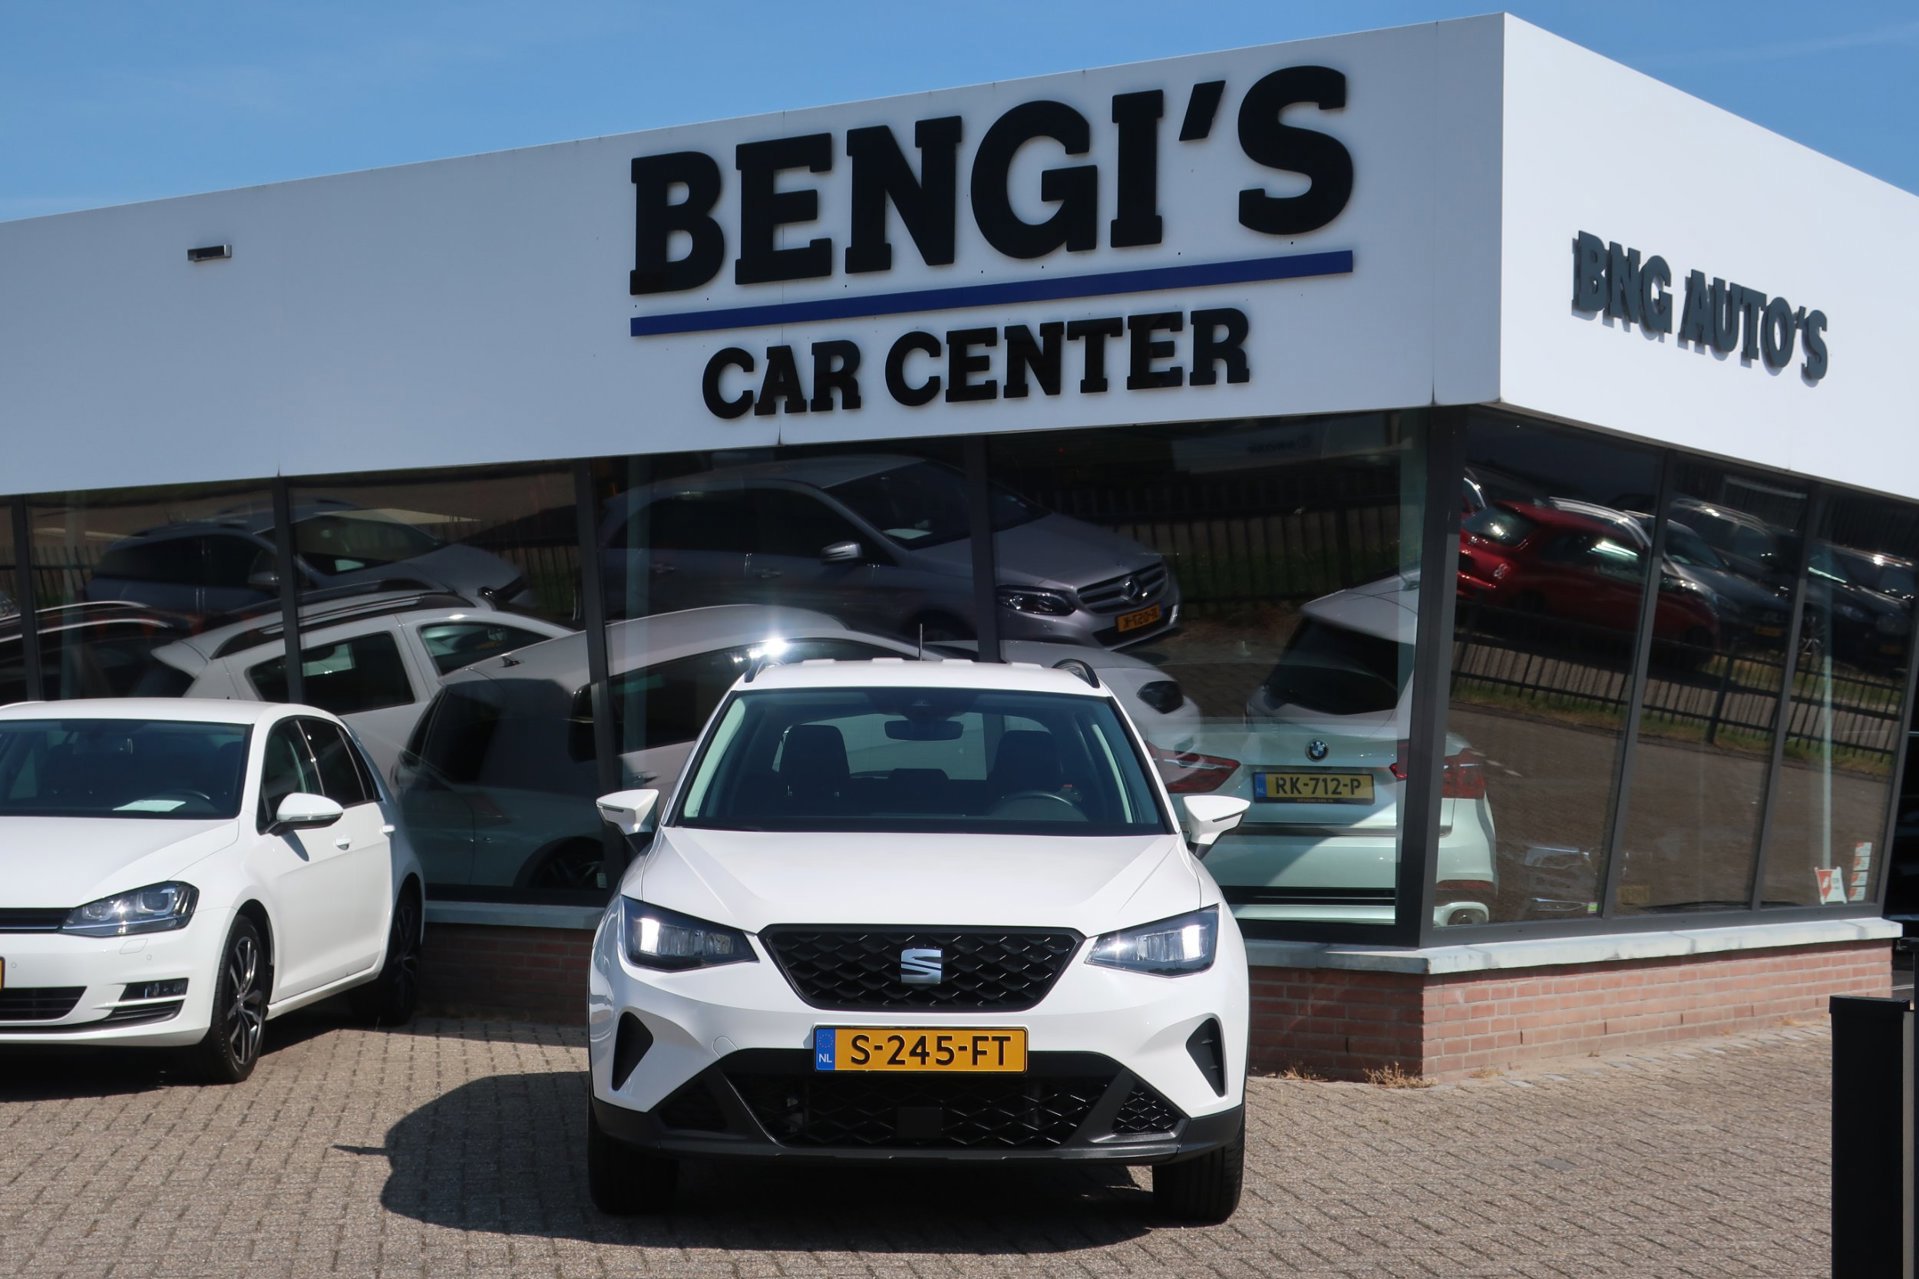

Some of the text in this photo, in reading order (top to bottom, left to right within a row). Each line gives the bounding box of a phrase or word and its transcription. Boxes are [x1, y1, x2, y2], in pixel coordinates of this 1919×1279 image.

[630, 65, 1354, 295] BENGI'S
[1572, 230, 1829, 381] BNG AUTO'S
[702, 308, 1250, 419] CAR CENTER
[1275, 777, 1361, 795] RK-712-P
[818, 1053, 832, 1063] NL
[851, 1034, 1011, 1066] S-245-FT
